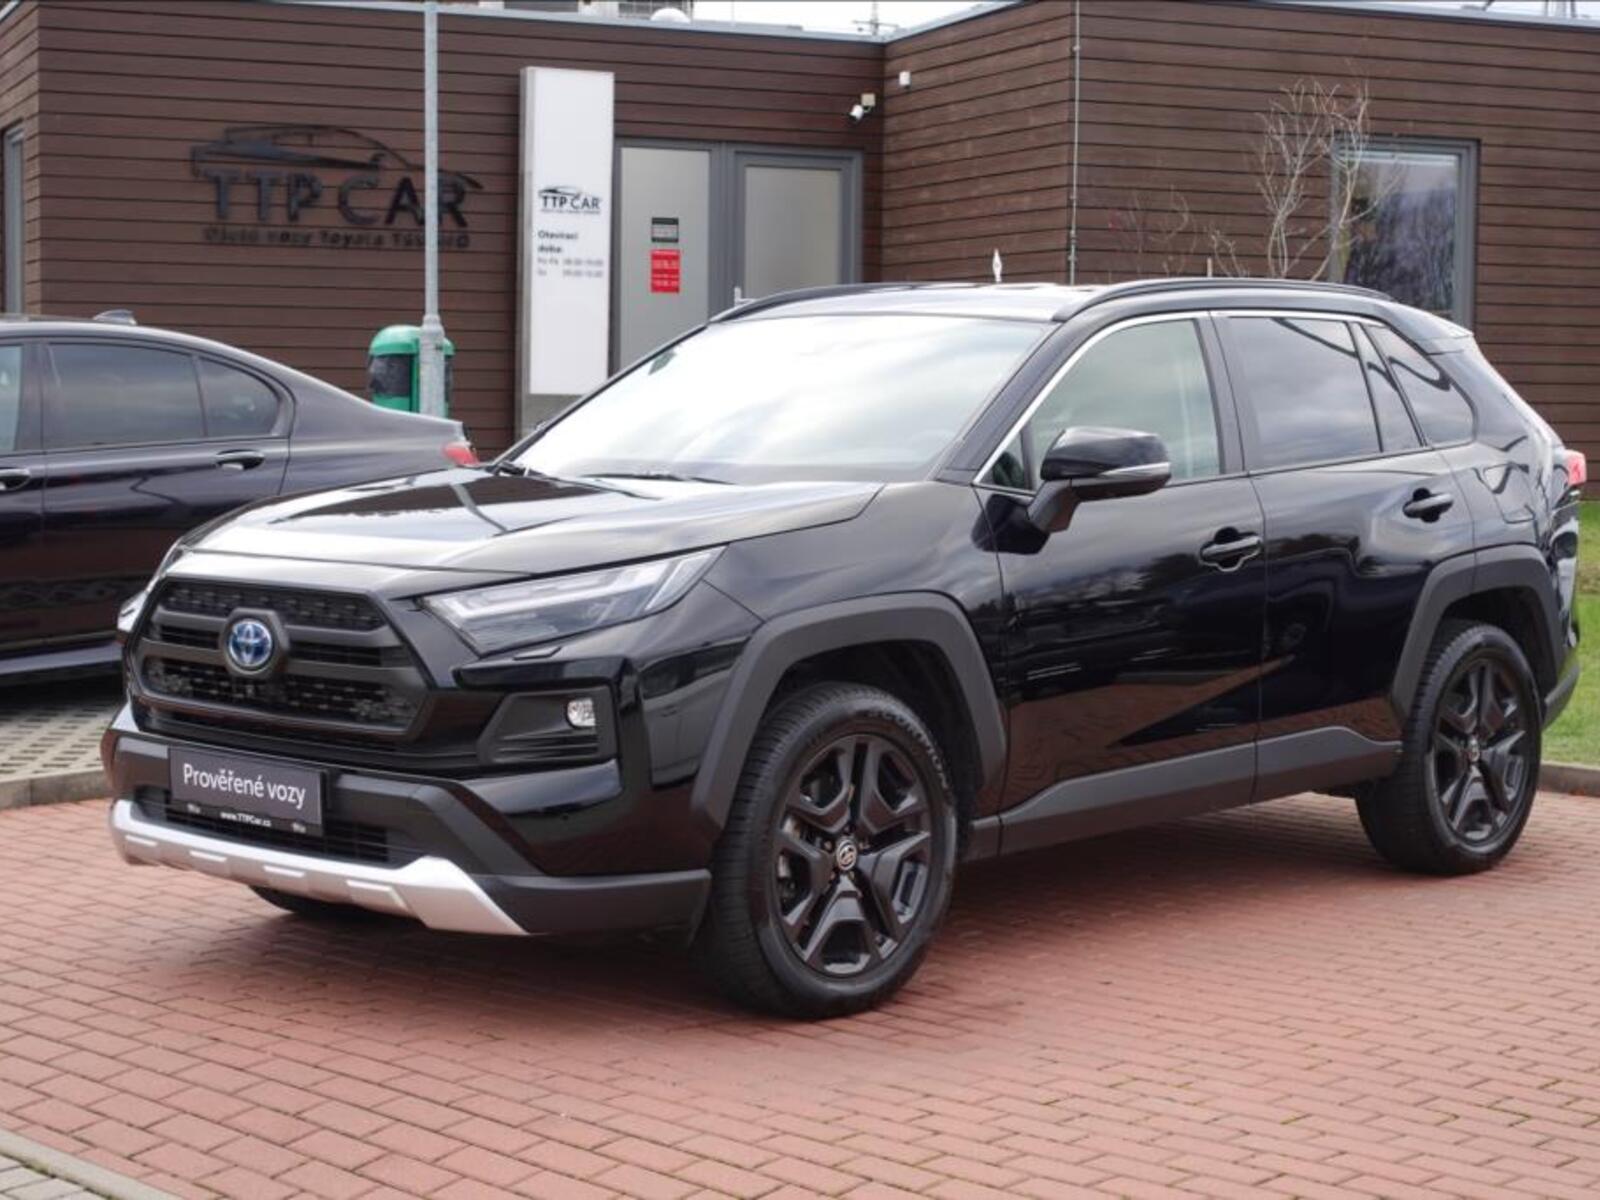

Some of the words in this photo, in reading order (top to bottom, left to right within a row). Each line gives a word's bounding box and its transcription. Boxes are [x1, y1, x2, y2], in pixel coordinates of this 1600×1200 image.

[205, 168, 322, 222] TTP
[337, 168, 468, 228] CAR
[542, 195, 567, 208] TTP
[570, 196, 600, 210] CAR
[183, 763, 264, 798] Prověřené
[267, 782, 306, 810] vozy
